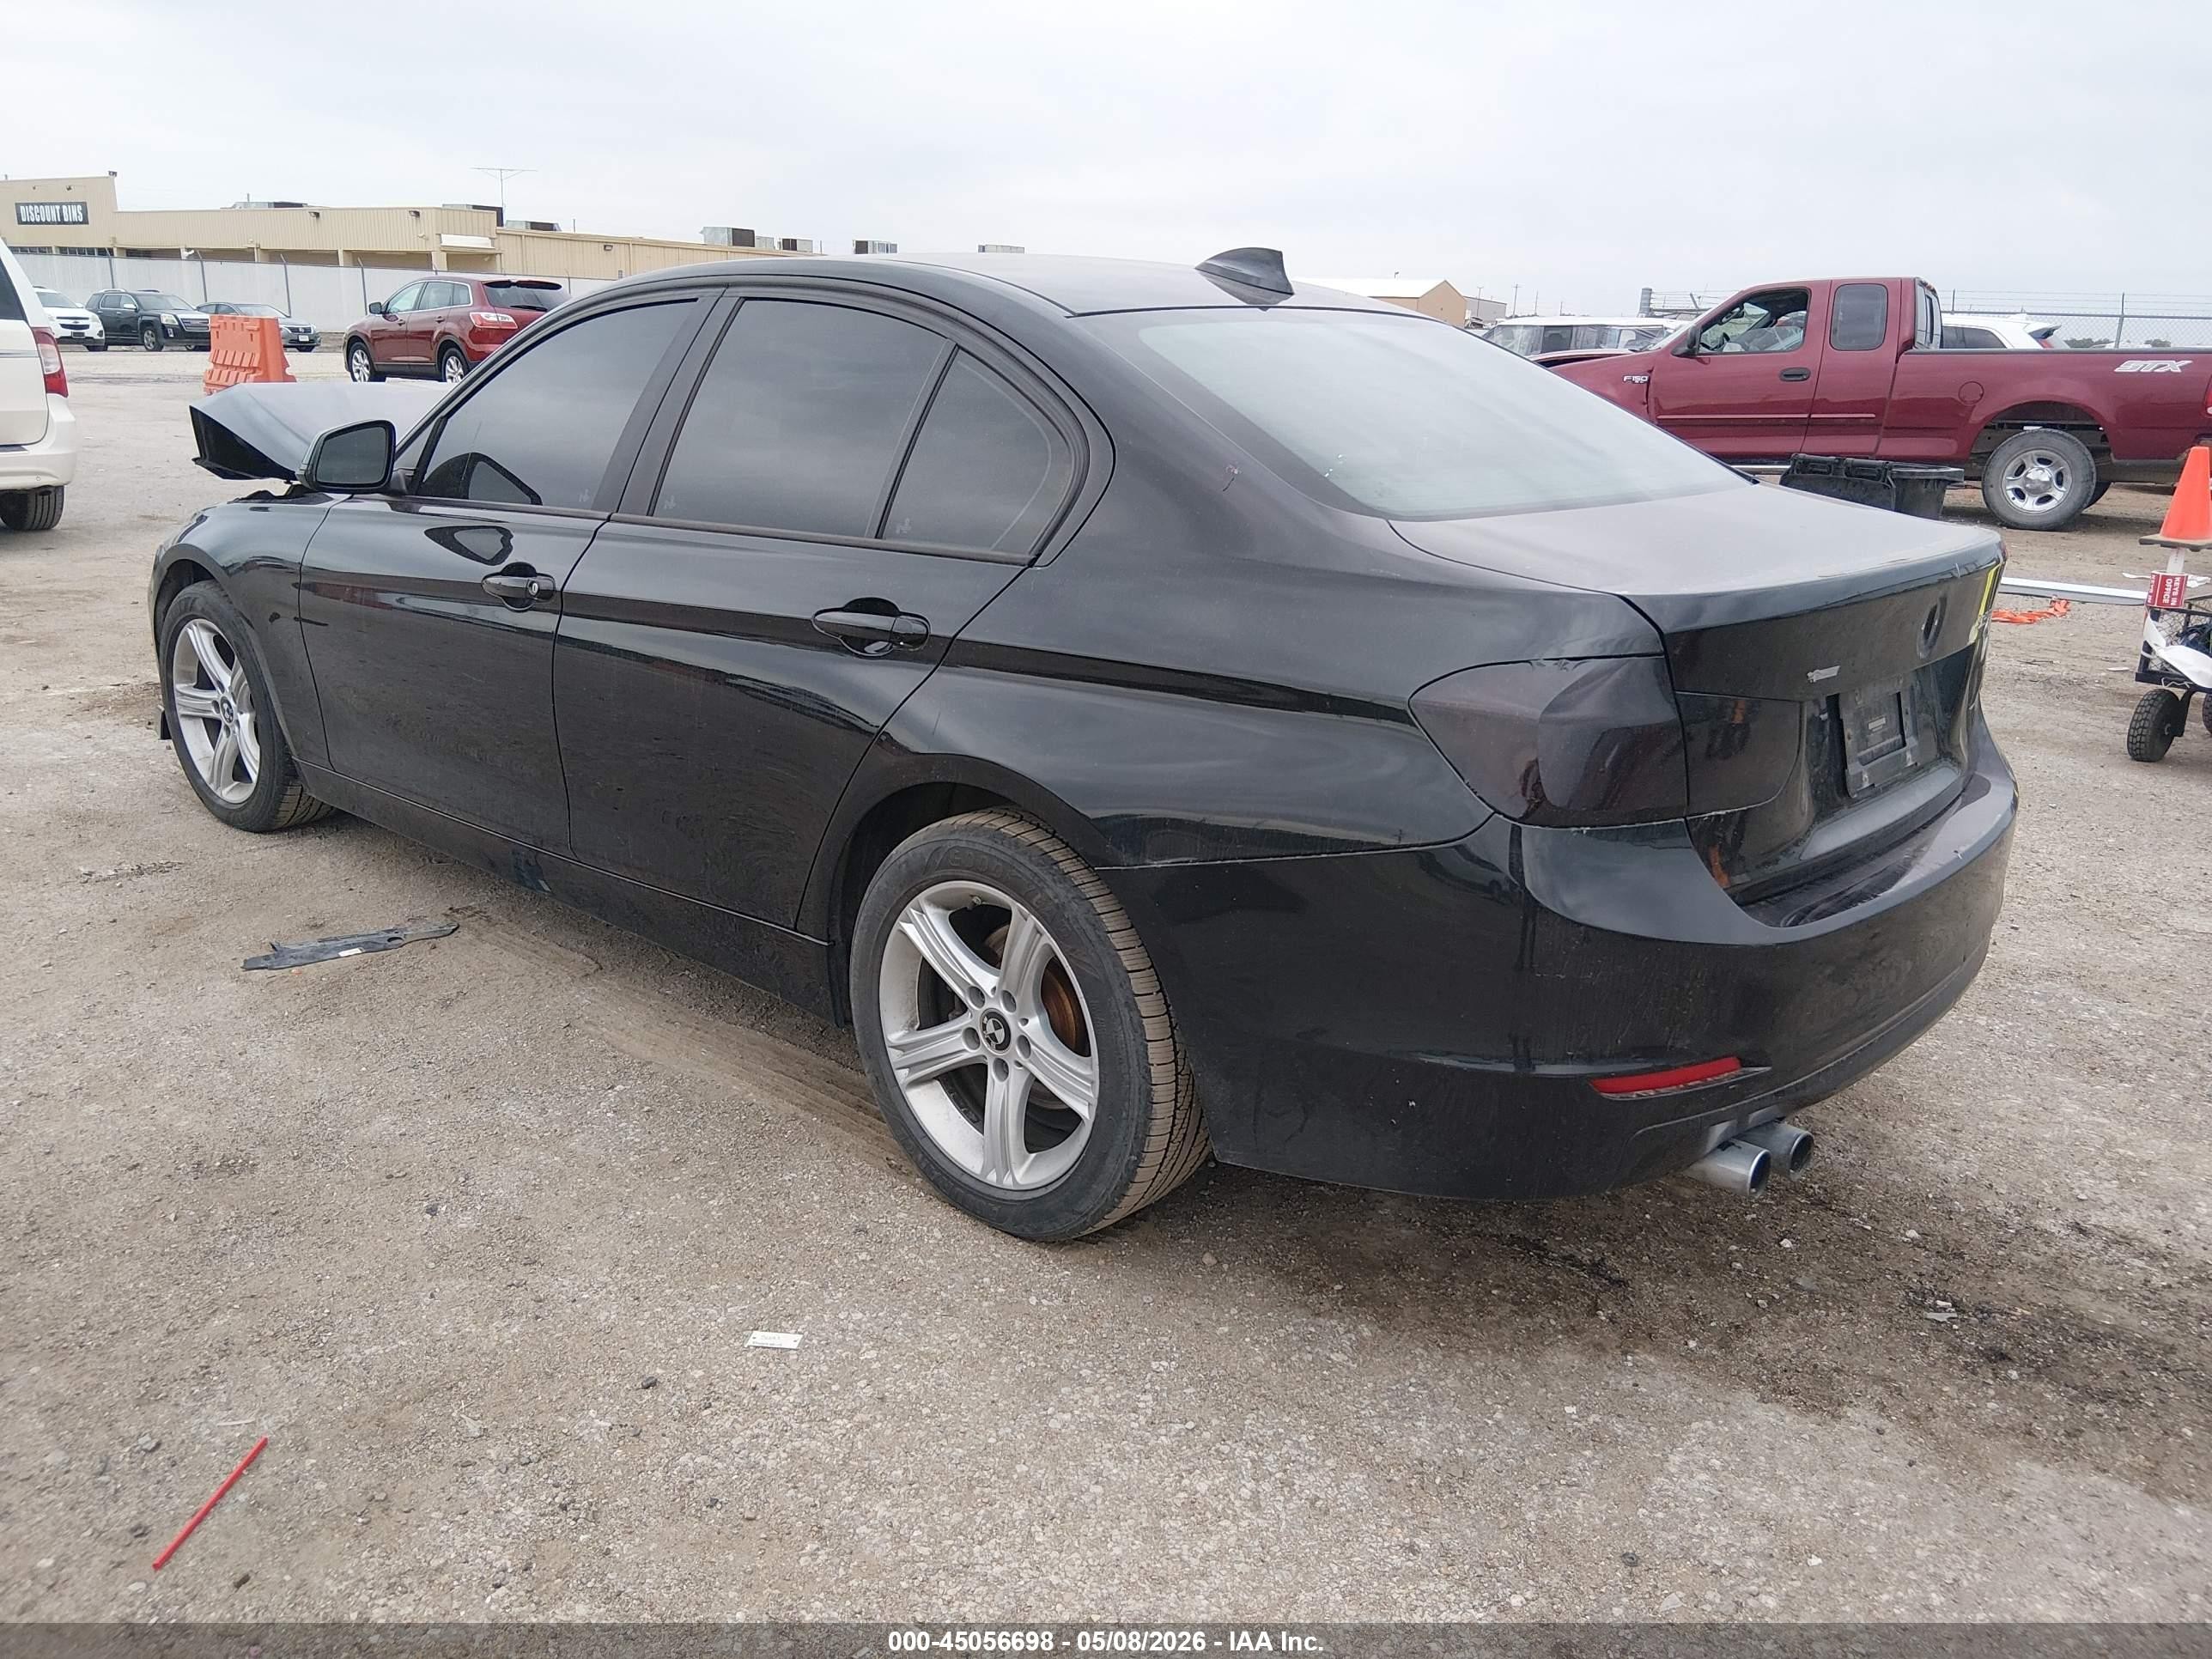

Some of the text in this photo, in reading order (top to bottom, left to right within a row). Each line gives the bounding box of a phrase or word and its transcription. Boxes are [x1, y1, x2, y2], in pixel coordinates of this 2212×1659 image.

[20, 204, 83, 222] DISCOUNT BINS
[2113, 360, 2193, 373] STX
[2162, 578, 2173, 604] OFFICE
[2170, 577, 2181, 606] KEYS IN
